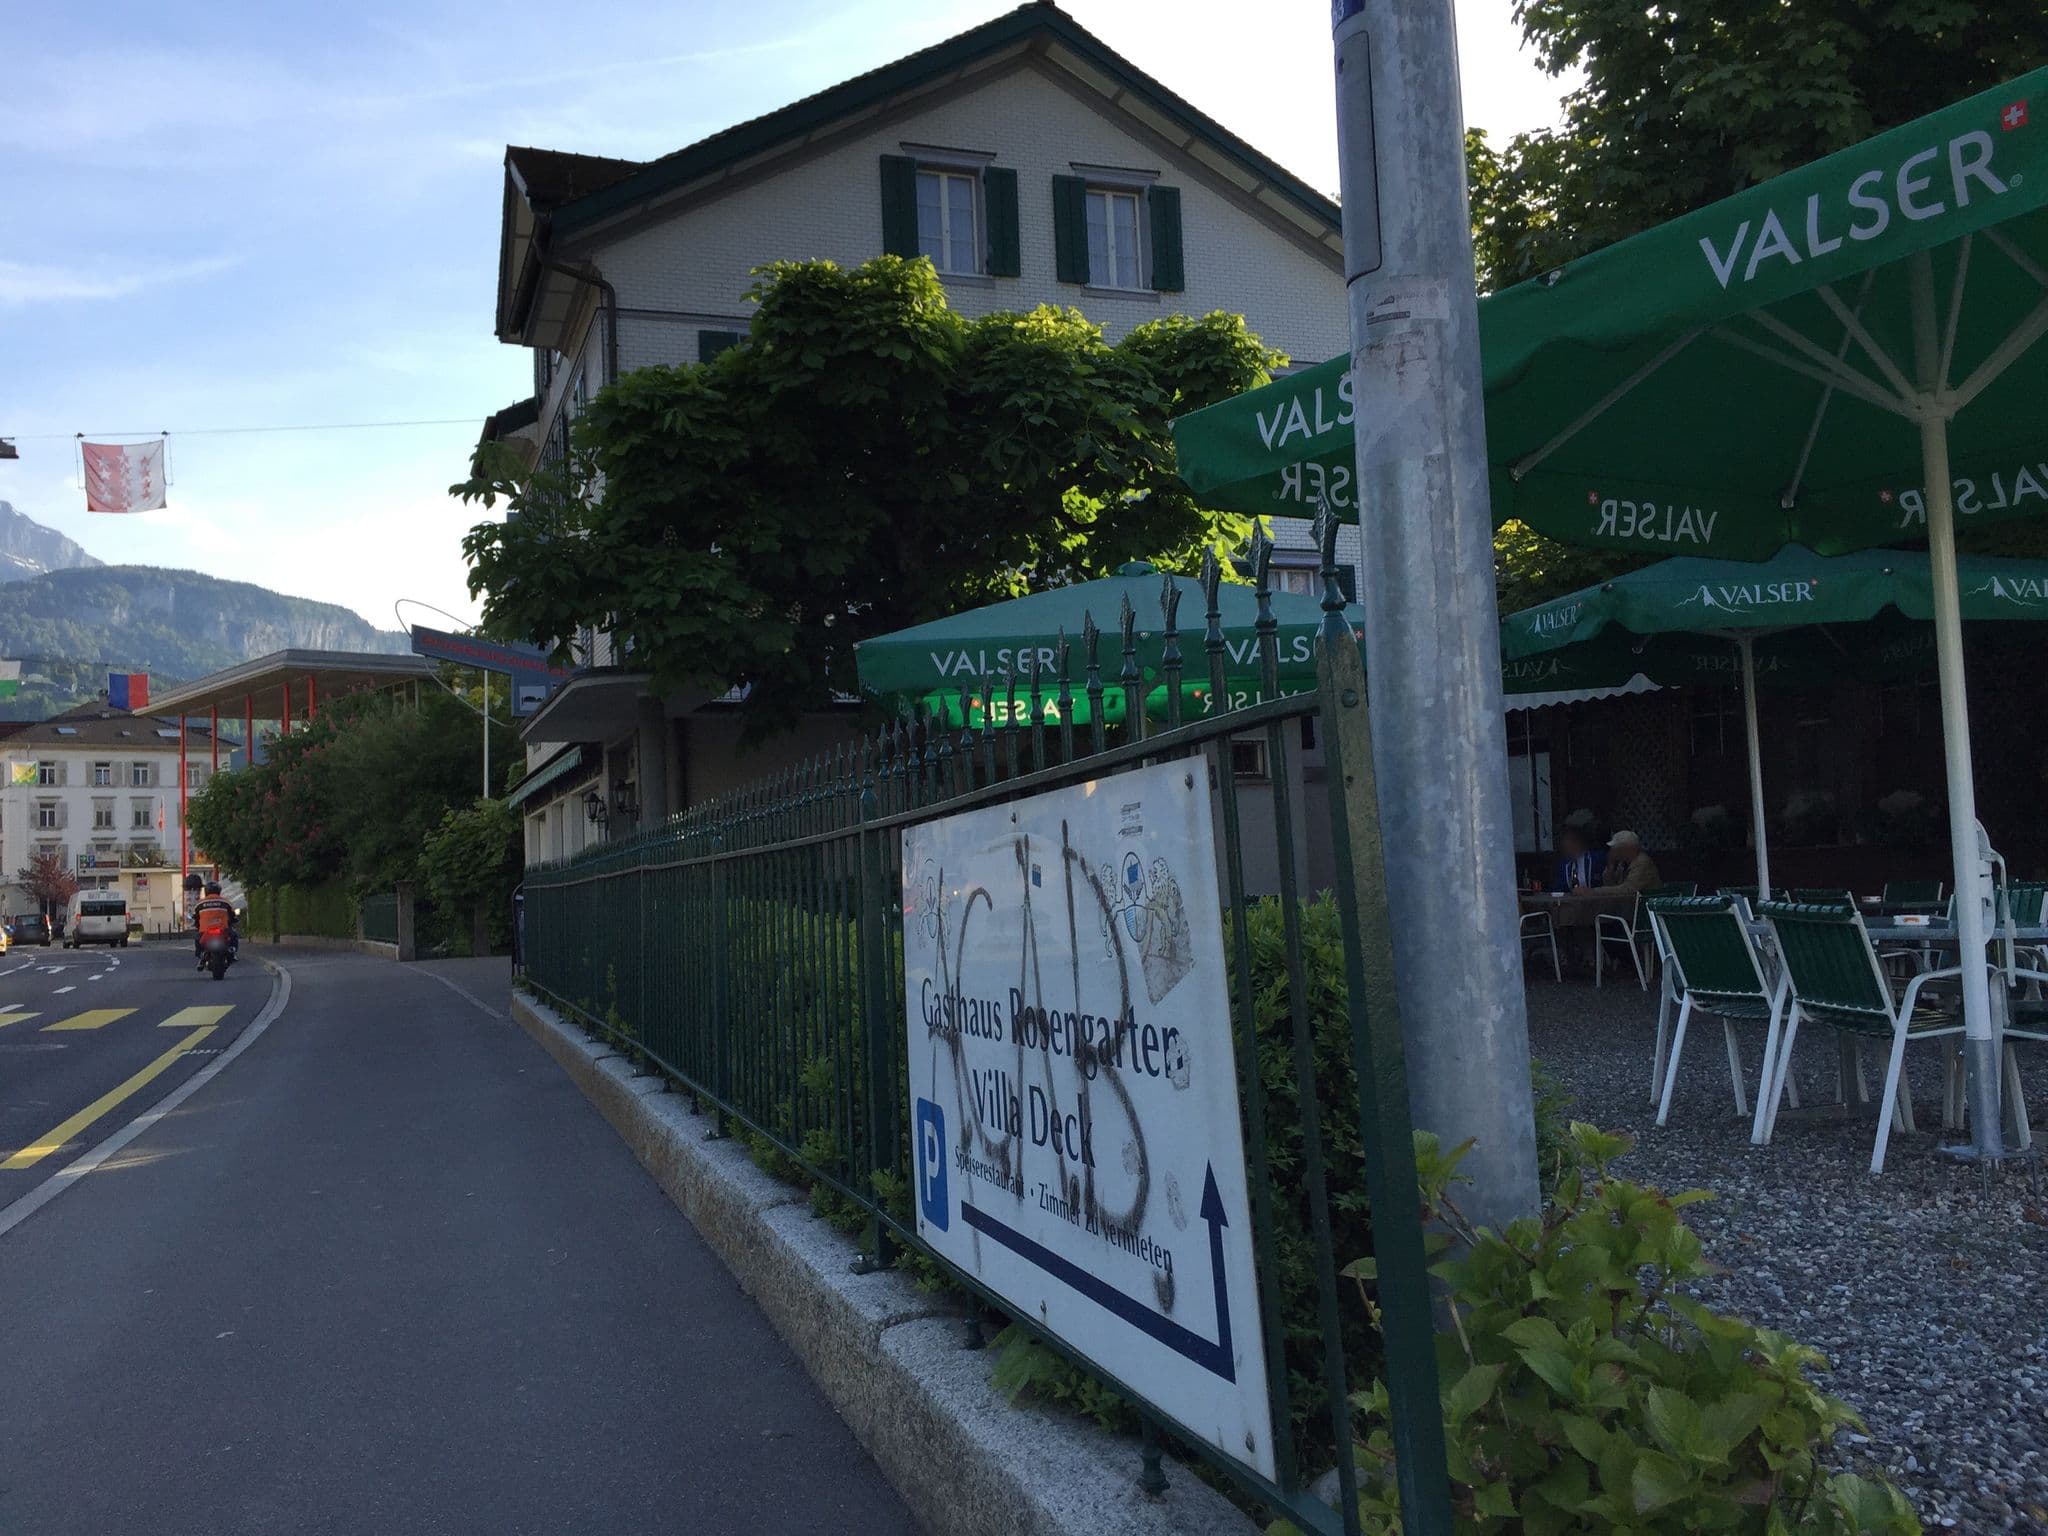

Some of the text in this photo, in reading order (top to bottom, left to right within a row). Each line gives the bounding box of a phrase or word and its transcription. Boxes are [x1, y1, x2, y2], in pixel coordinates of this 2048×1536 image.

[1699, 130, 2009, 290] VALSER
[1256, 371, 1356, 451] VALS
[1543, 605, 1577, 630] VALSER
[1718, 581, 1816, 605] VALSER
[930, 648, 1057, 677] VALSER
[1225, 635, 1311, 665] VALS
[922, 978, 1183, 1080] Gasthaus Rosengarten
[973, 1069, 1096, 1168] Villa Deck
[923, 1119, 940, 1202] P
[955, 1146, 1025, 1200] Speiserestaurant
[1039, 1182, 1080, 1227] Zimmer
[1101, 1221, 1173, 1274] vermieten
